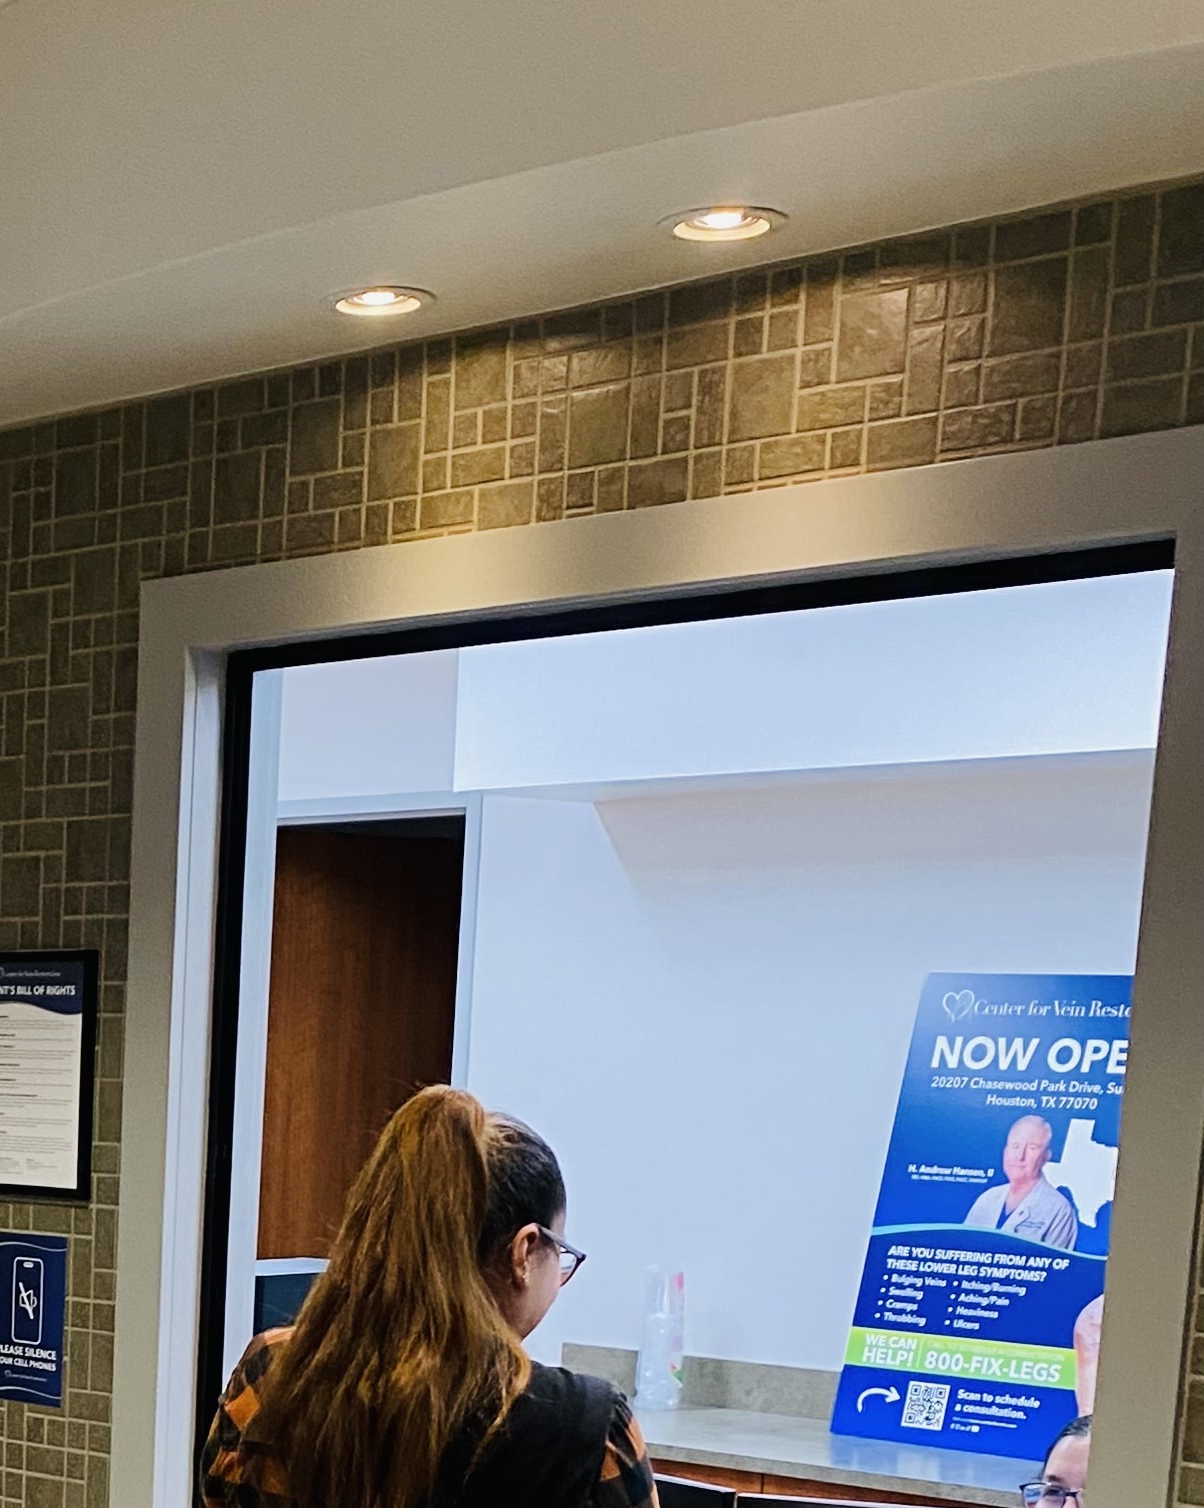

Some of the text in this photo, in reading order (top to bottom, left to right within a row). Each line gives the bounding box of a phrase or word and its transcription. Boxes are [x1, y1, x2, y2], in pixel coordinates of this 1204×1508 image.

[16, 985, 32, 995] BILL
[33, 985, 45, 995] OF
[46, 985, 76, 996] RIGHTS
[974, 999, 1026, 1017] Center
[1027, 1000, 1051, 1017] for
[1054, 1000, 1086, 1018] Vein
[931, 1036, 1040, 1071] NOW
[931, 1076, 969, 1089] 20207
[970, 1077, 1037, 1092] Chasewood
[1040, 1079, 1067, 1092] Park
[1068, 1081, 1104, 1096] Drive,
[986, 1094, 1098, 1110] Houston, TX 77070
[888, 1245, 1070, 1270] ARE YOU SUFFERING FROM ANY OF
[887, 1258, 1047, 1282] THESE LOWER LEG SYMPTOMS?
[891, 1273, 947, 1287] Bulging Veins
[888, 1286, 924, 1300] Swelling
[961, 1280, 1027, 1297] Itching/Burning
[957, 1293, 1010, 1306] Aching/Pain
[883, 1311, 927, 1327] Throbbing
[956, 1306, 999, 1319] Heaviness
[953, 1319, 980, 1330] Ulcers
[866, 1334, 918, 1350] WE CAN
[25, 1346, 56, 1360] SILENCE
[862, 1348, 915, 1368] HELP!
[14, 1357, 29, 1367] CELL
[29, 1360, 56, 1372] PHONES
[924, 1350, 1063, 1383] 800-FIX-LEGS
[957, 1389, 1040, 1408] Scan to schedule
[963, 1404, 1027, 1420] consultation.
